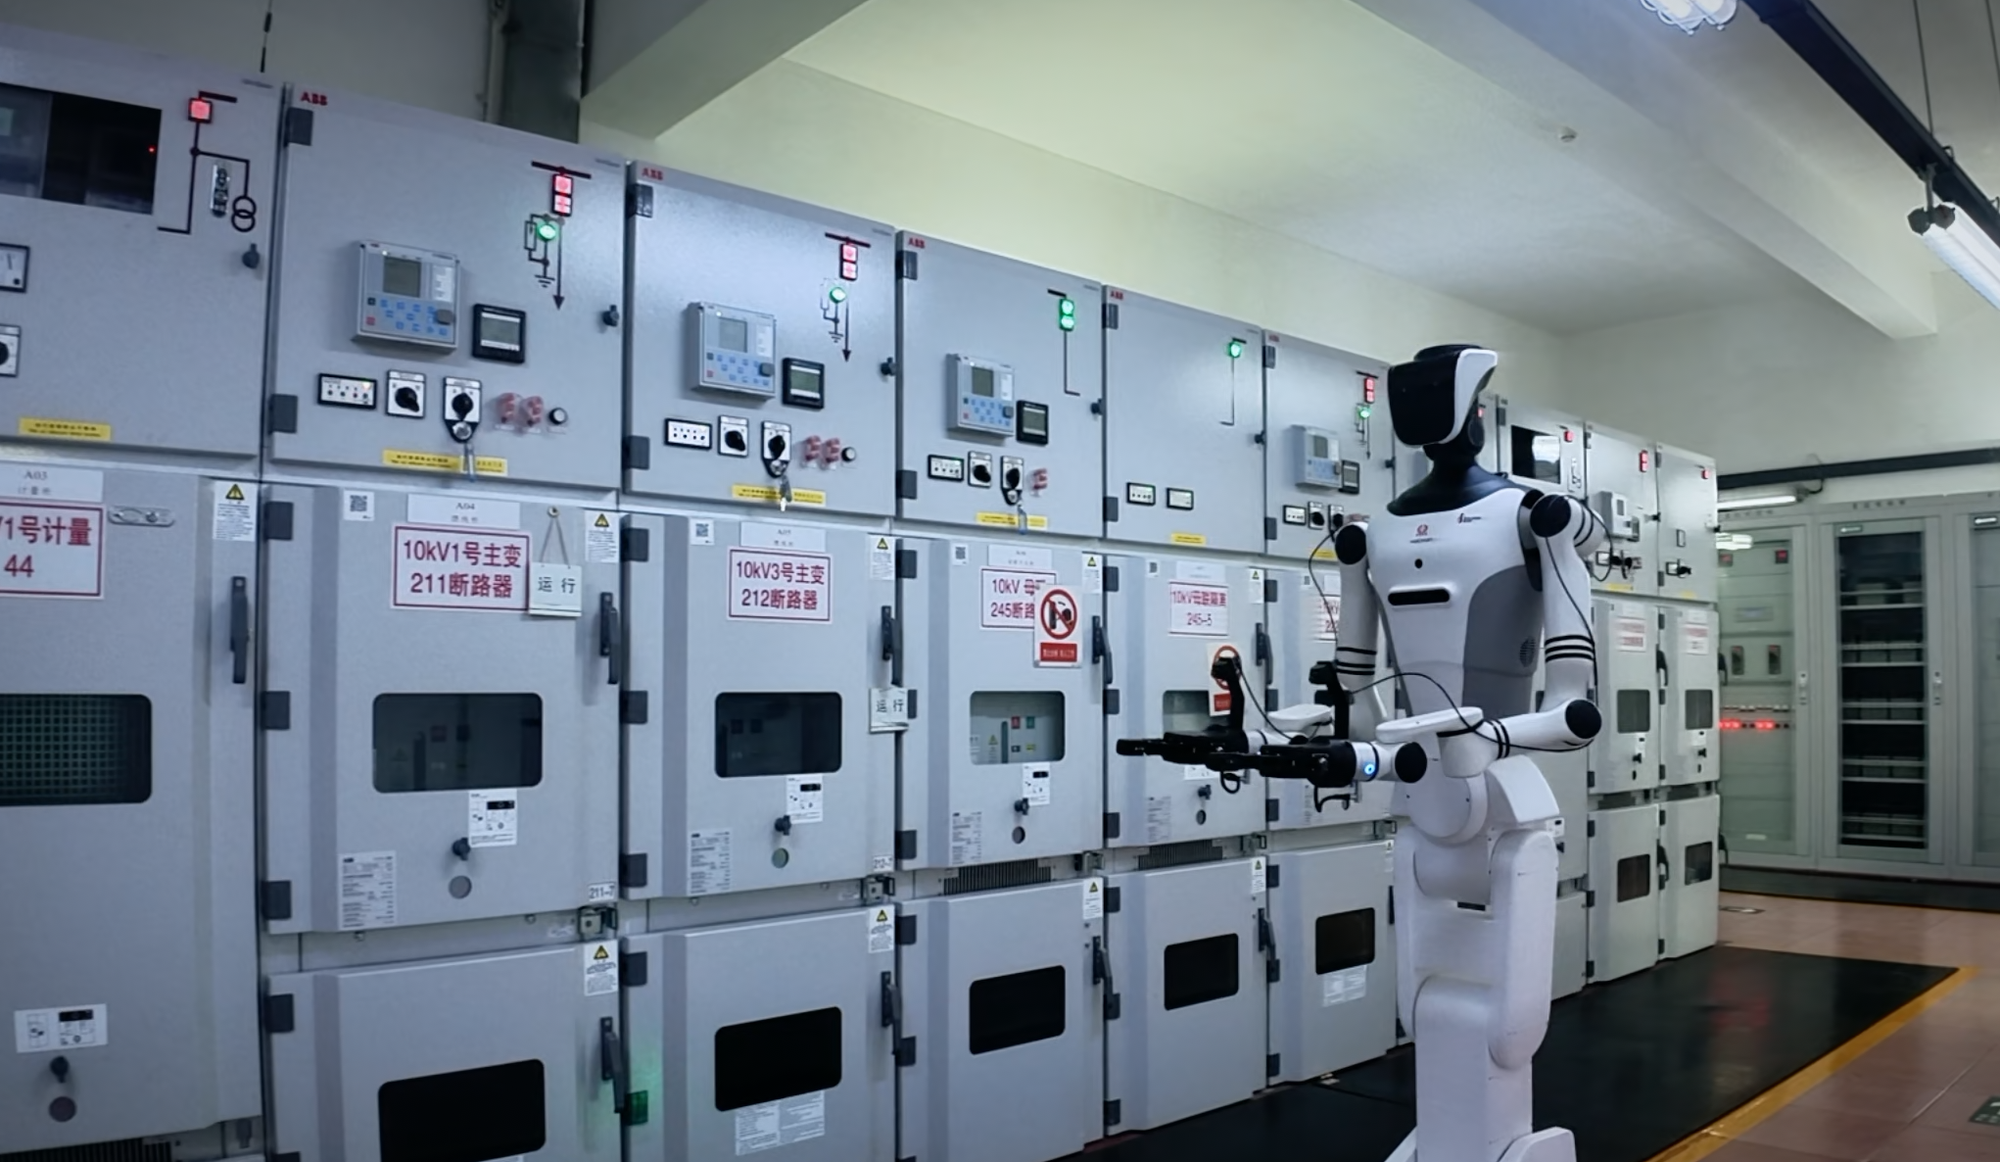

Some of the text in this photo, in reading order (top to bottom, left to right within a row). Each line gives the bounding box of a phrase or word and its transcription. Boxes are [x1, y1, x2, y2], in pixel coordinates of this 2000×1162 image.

[300, 91, 328, 106] ABB
[642, 167, 663, 181] ABB
[0, 515, 92, 546] 1号计量
[403, 540, 521, 568] 10kV1号主变
[736, 561, 825, 585] 10kV3号主变
[411, 572, 512, 599] 211断路器
[538, 577, 576, 594] 运行
[992, 579, 1020, 594] 10kV
[742, 588, 817, 610] 212断路器
[991, 602, 1034, 619] 245断路
